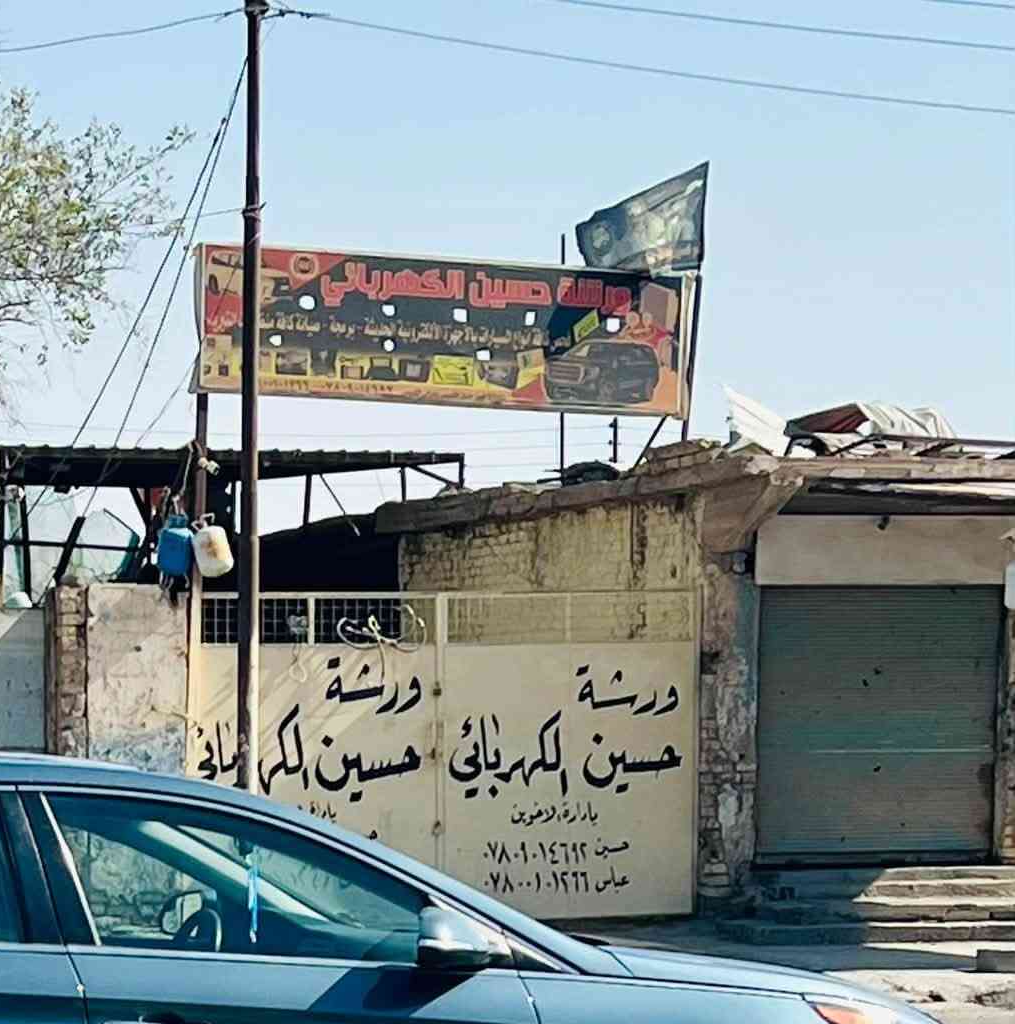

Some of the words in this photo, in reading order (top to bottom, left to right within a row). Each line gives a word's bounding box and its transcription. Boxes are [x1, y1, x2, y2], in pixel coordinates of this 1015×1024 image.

[468, 271, 552, 308] حسين
[556, 274, 632, 318] ورشة
[325, 656, 422, 715] ورشة
[575, 664, 679, 717] ورشة
[315, 725, 421, 803] حسين
[448, 709, 568, 798] الكهربائي
[582, 732, 683, 794] حسين
[594, 837, 630, 860] حسين
[595, 865, 630, 894] عباس
